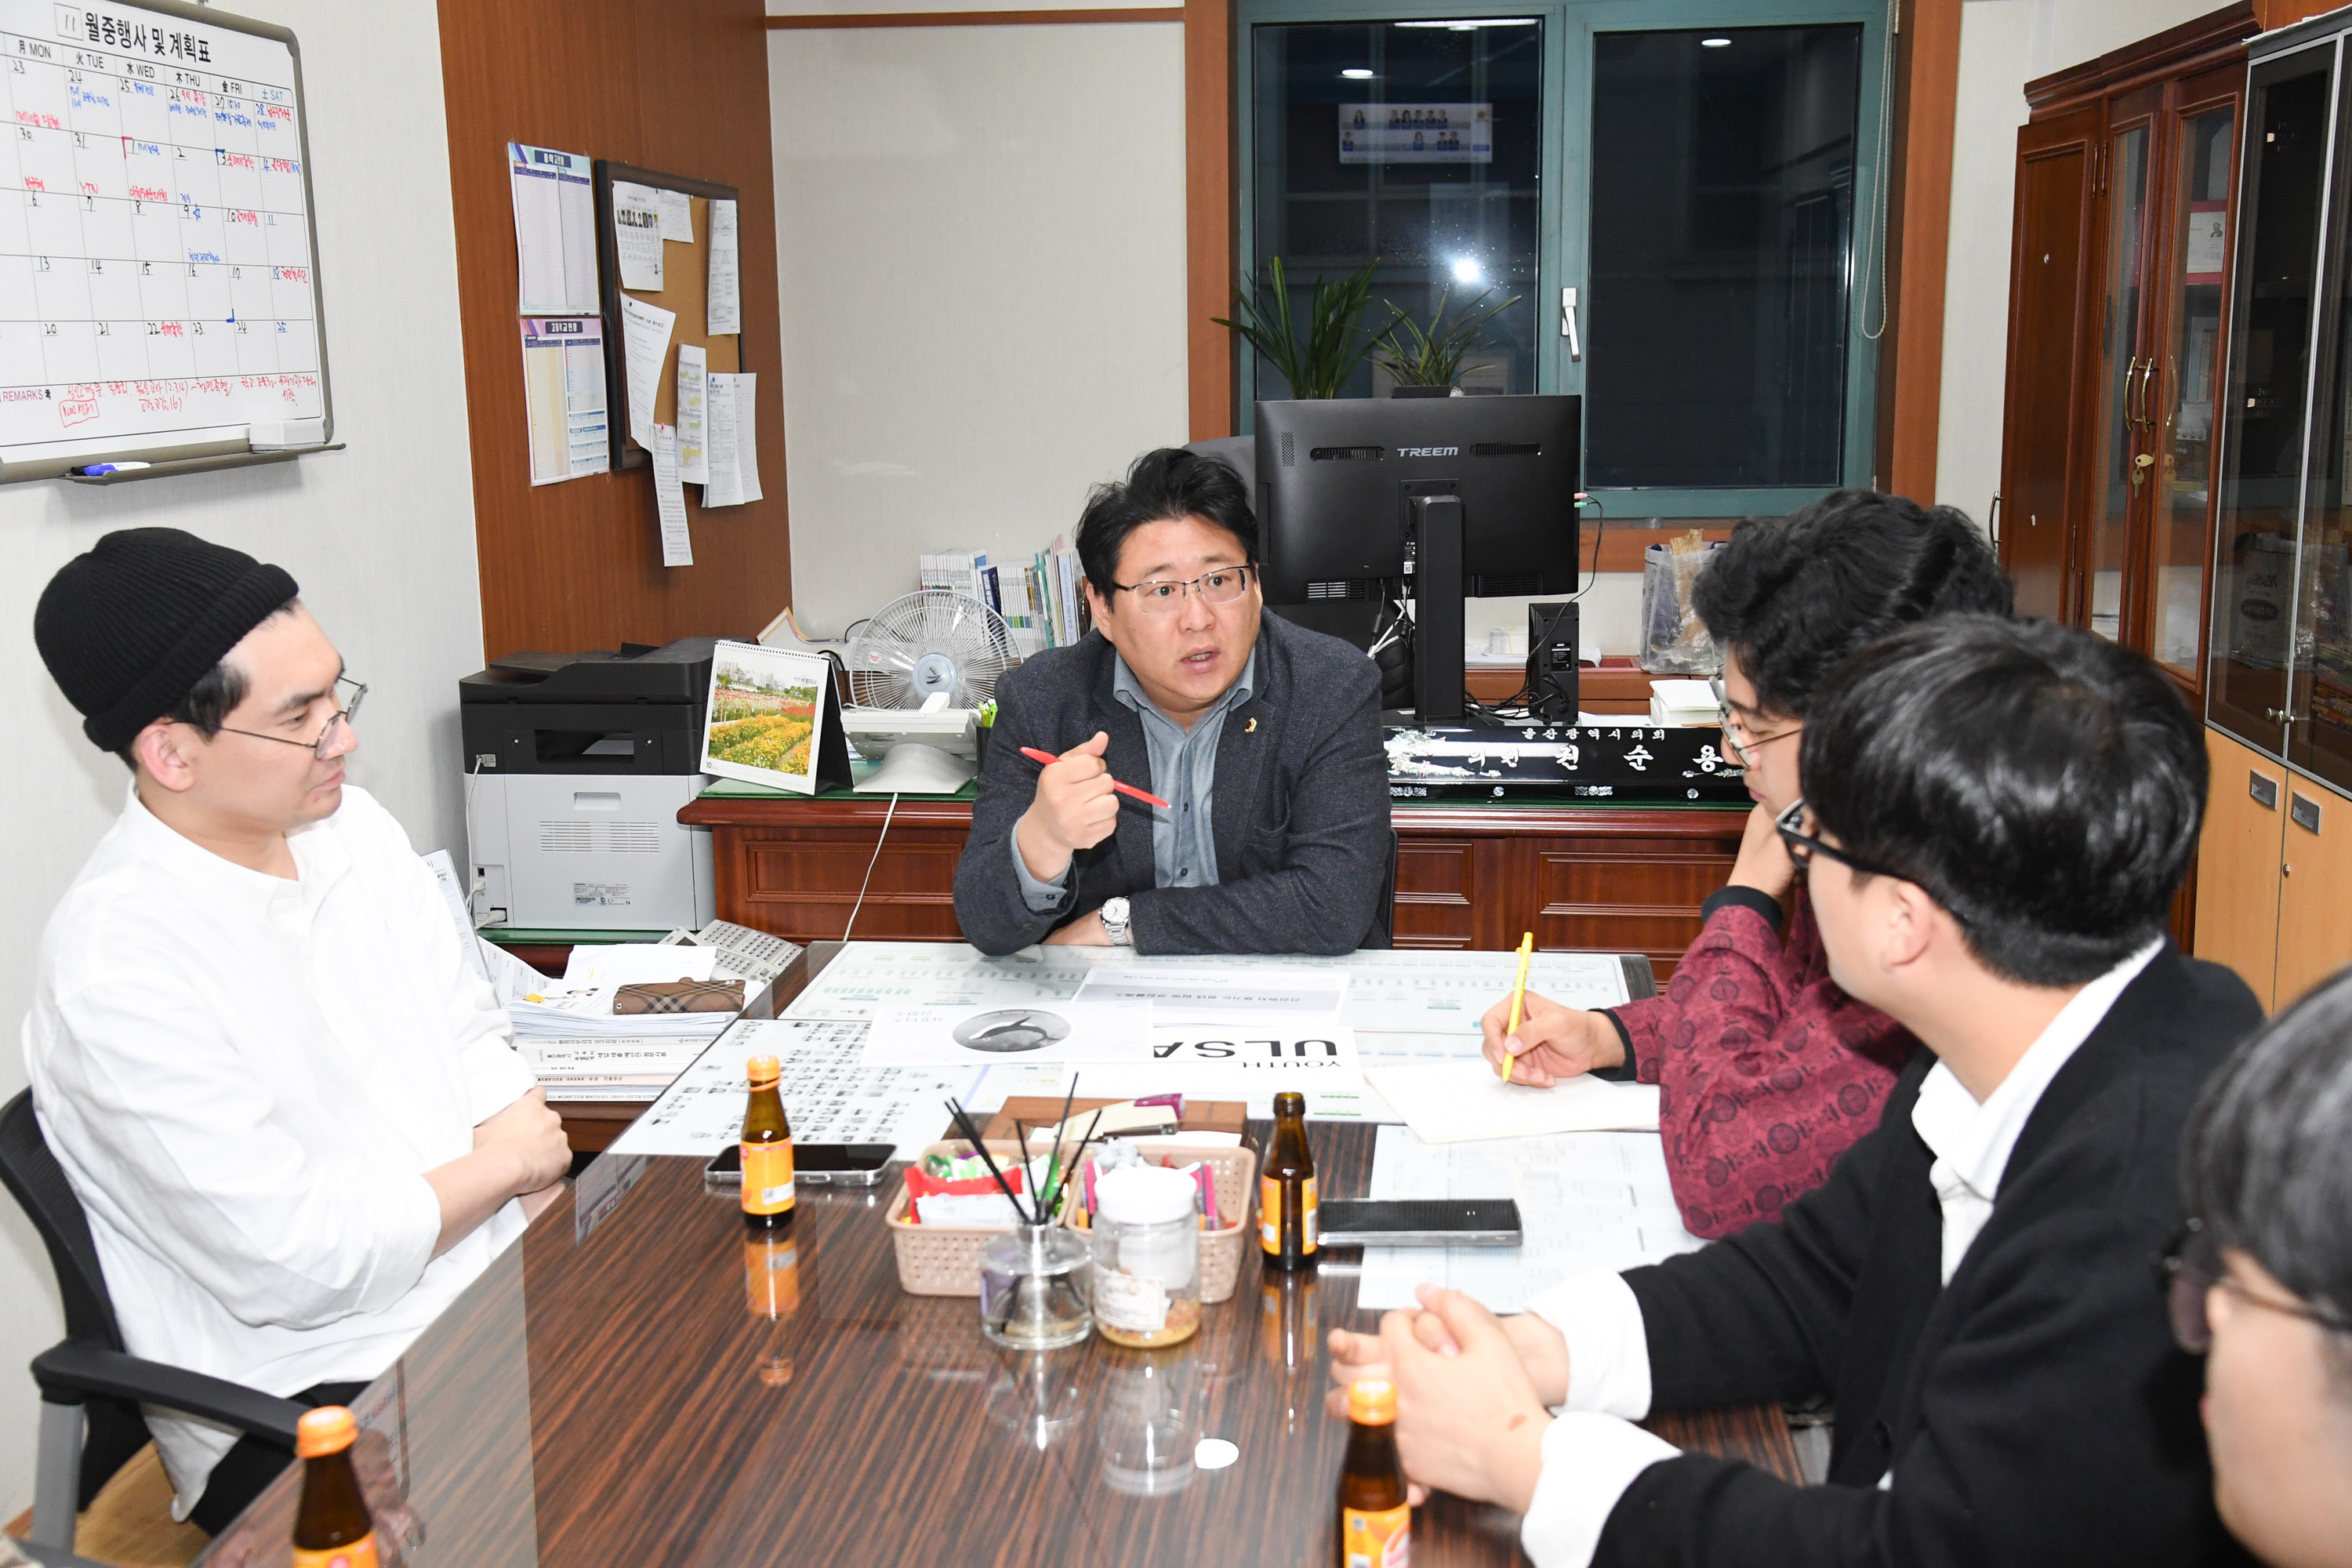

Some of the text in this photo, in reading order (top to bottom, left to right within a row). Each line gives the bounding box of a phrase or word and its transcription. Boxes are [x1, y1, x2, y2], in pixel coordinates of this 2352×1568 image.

[85, 12, 212, 64] 월중행사 및 계획표
[29, 44, 52, 59] MON
[86, 54, 104, 69] TUE
[136, 67, 155, 78] WED
[185, 74, 201, 87] THU
[230, 82, 242, 94] FRI
[270, 90, 283, 101] SAT
[3, 389, 43, 401] REMARKS
[1397, 447, 1459, 458] TREEM
[1522, 728, 1665, 741] 울산광역시의회
[1468, 744, 1724, 773] 의원 권순용
